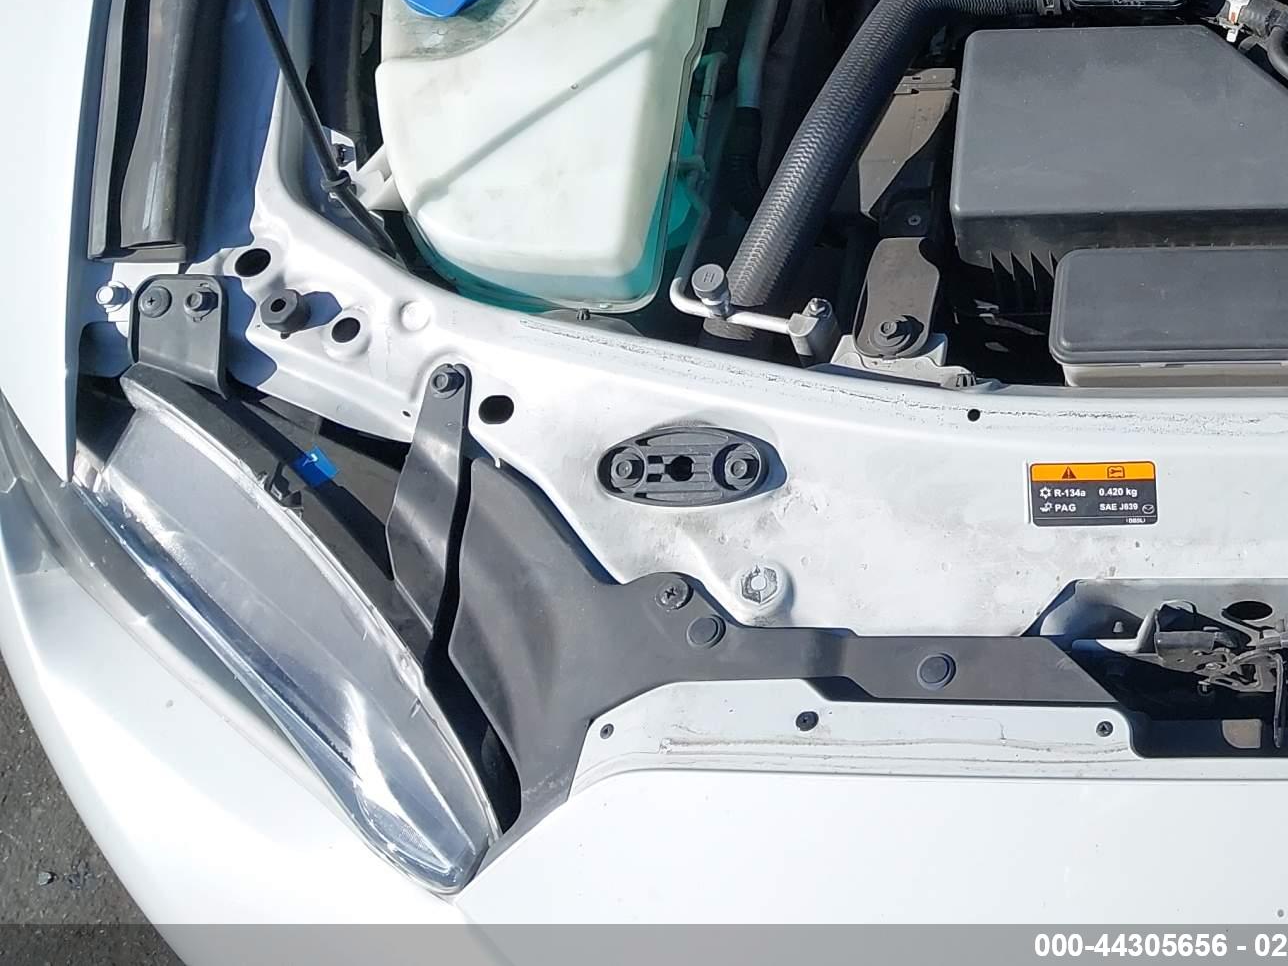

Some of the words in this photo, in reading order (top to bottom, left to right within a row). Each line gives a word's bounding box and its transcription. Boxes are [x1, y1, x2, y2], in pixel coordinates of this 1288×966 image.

[1054, 488, 1086, 497] R-134a
[1098, 487, 1124, 496] 0.420
[1125, 487, 1138, 497] kg
[1054, 503, 1077, 512] PAG
[1099, 503, 1118, 511] SAE
